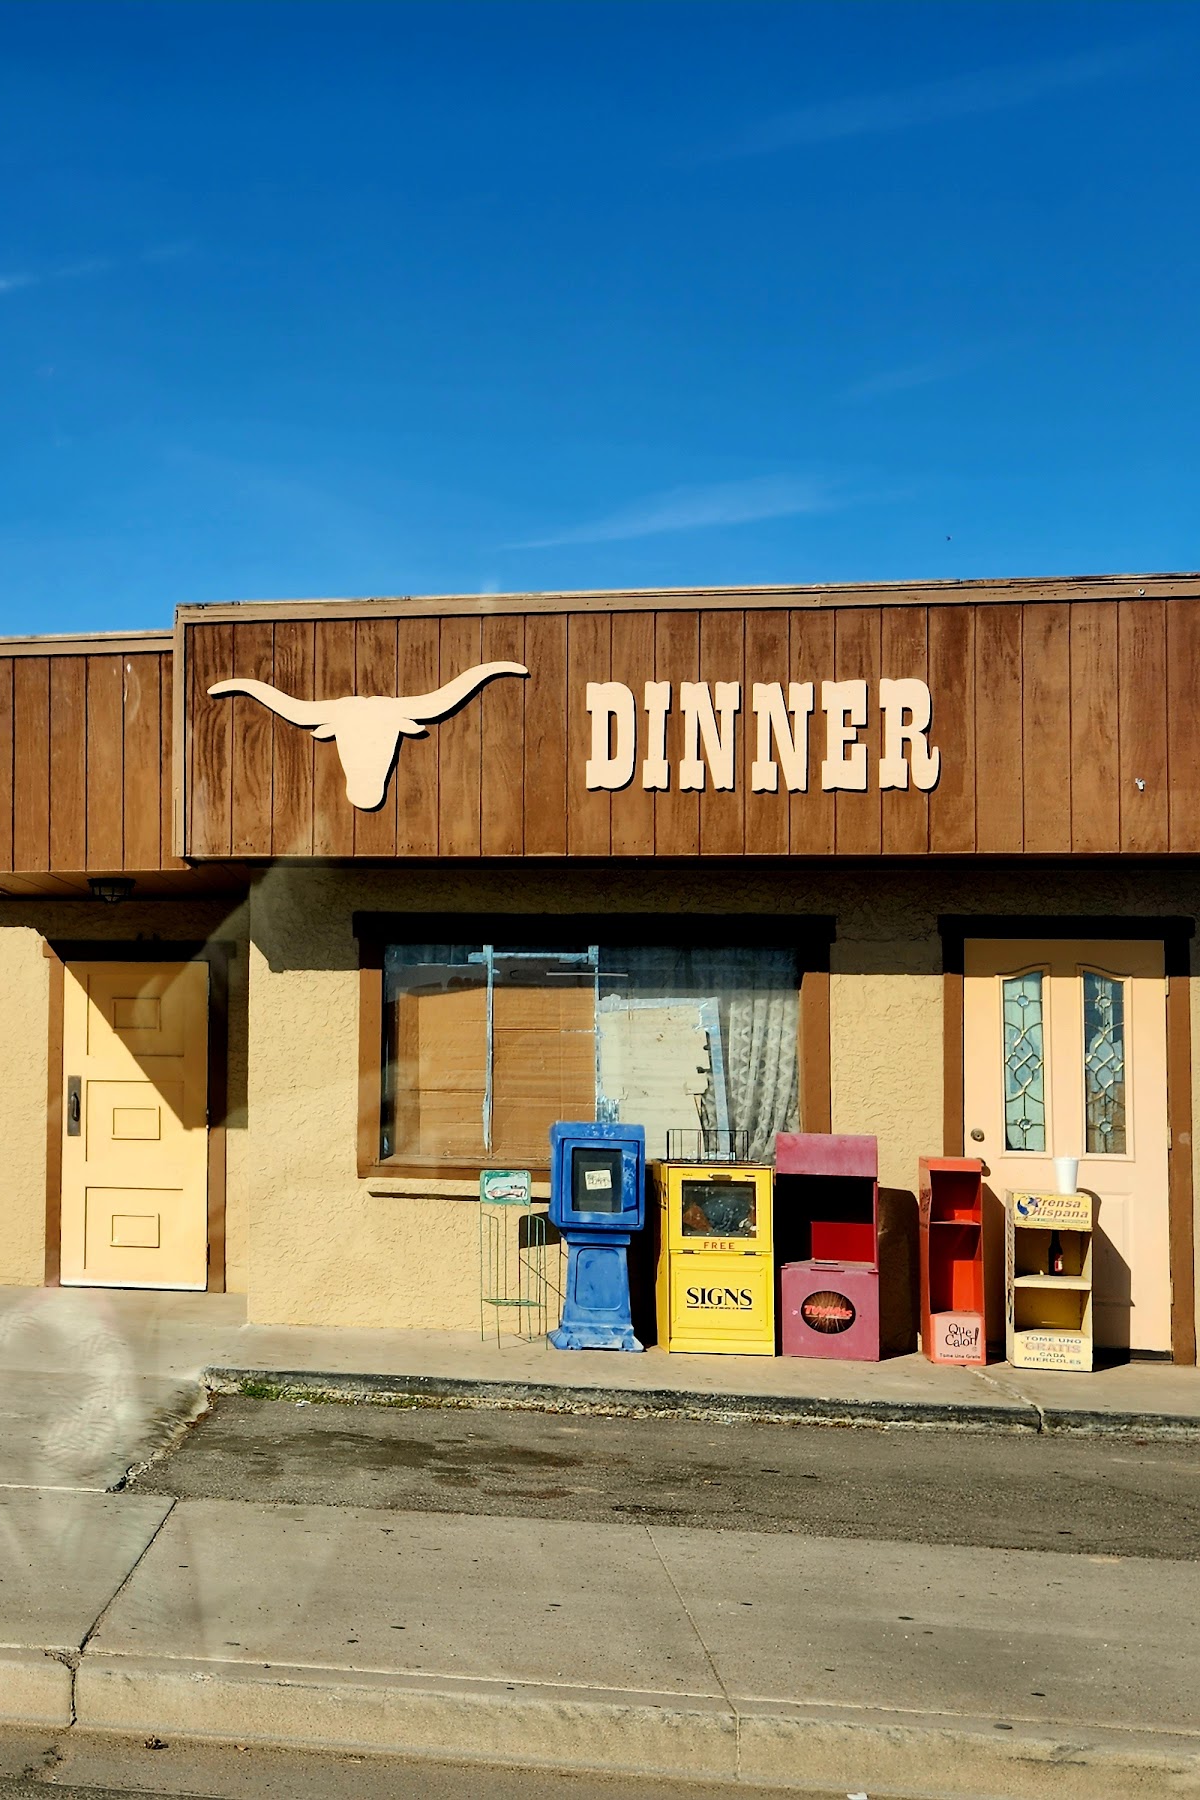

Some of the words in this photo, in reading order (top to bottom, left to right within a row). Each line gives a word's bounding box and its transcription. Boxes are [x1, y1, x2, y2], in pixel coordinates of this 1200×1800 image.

[585, 678, 940, 793] DINNER
[1034, 1196, 1081, 1208] Prensa
[703, 1241, 735, 1250] FREE
[686, 1286, 753, 1307] SIGNS
[948, 1323, 972, 1338] Que
[1025, 1342, 1081, 1354] GRATIS
[1024, 1356, 1082, 1365] MIERCOLES
